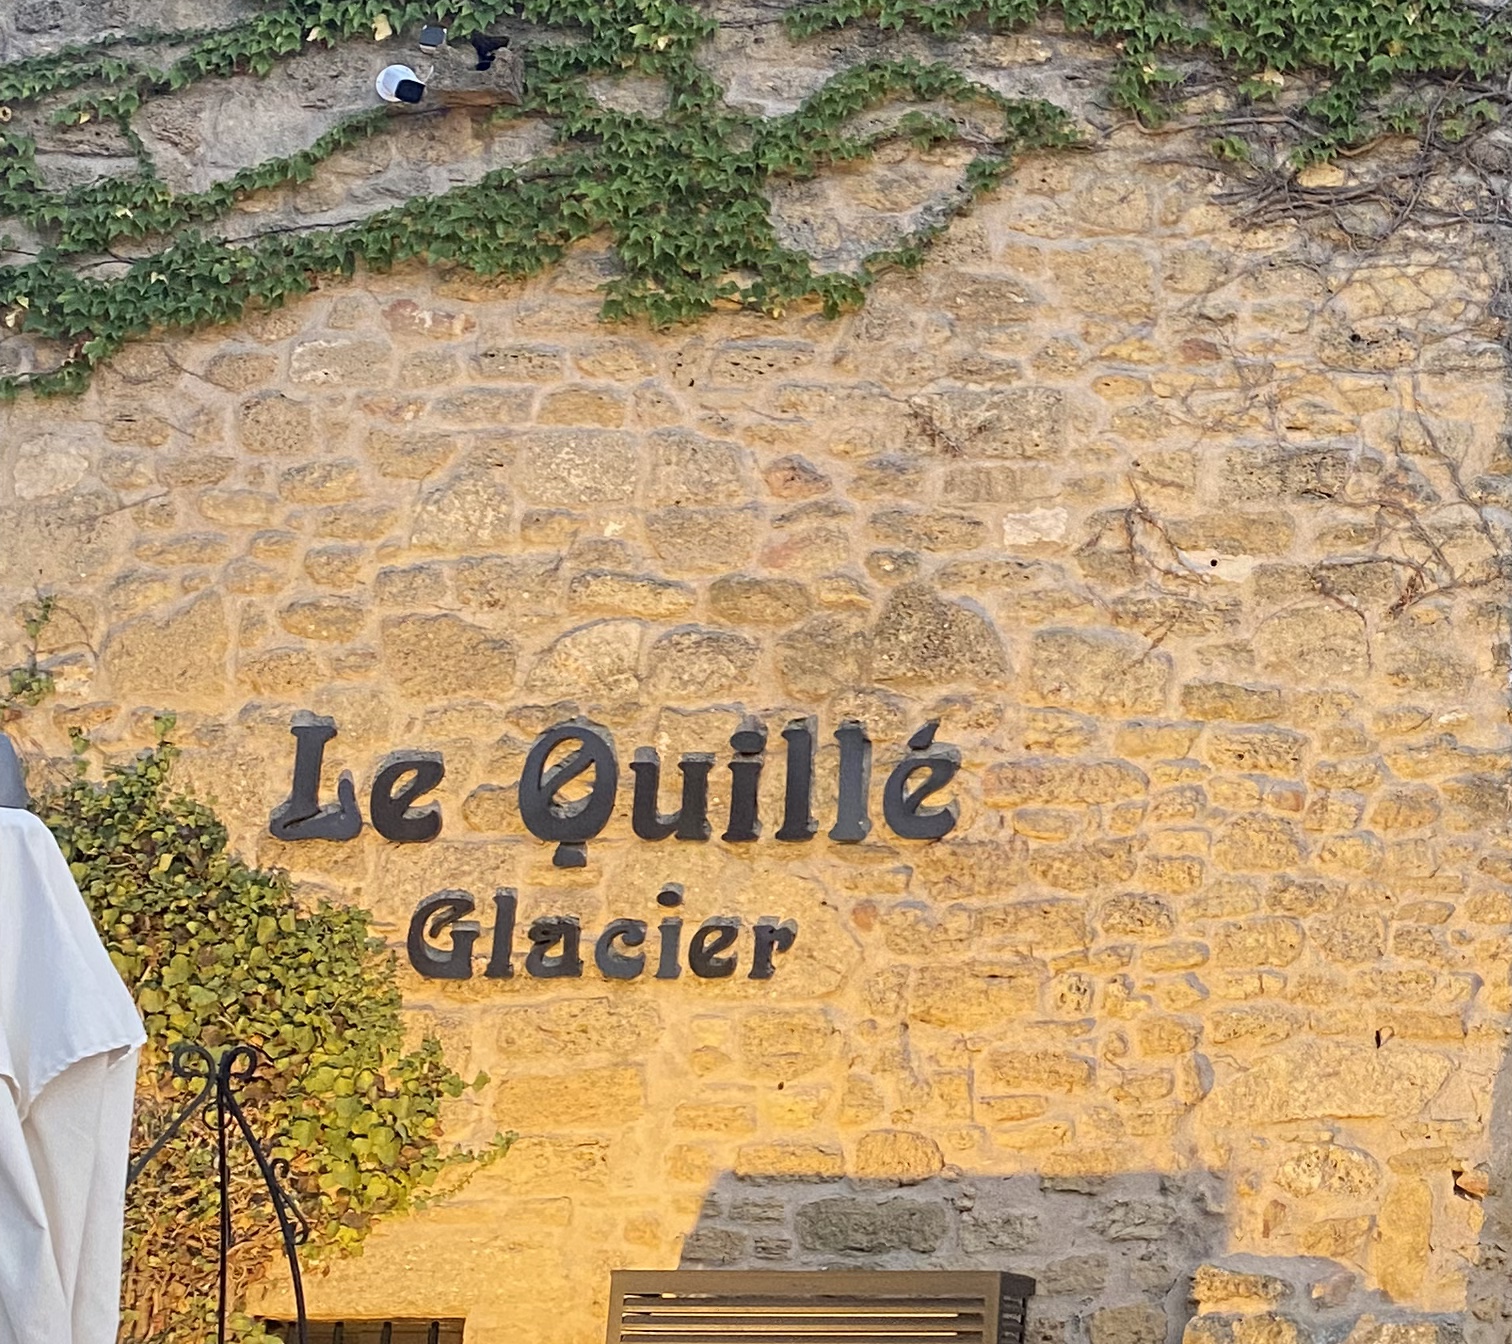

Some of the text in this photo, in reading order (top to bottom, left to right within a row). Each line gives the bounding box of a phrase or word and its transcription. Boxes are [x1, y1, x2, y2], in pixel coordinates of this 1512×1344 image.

[269, 710, 964, 868] Le Quillé
[406, 882, 798, 981] Glacier
